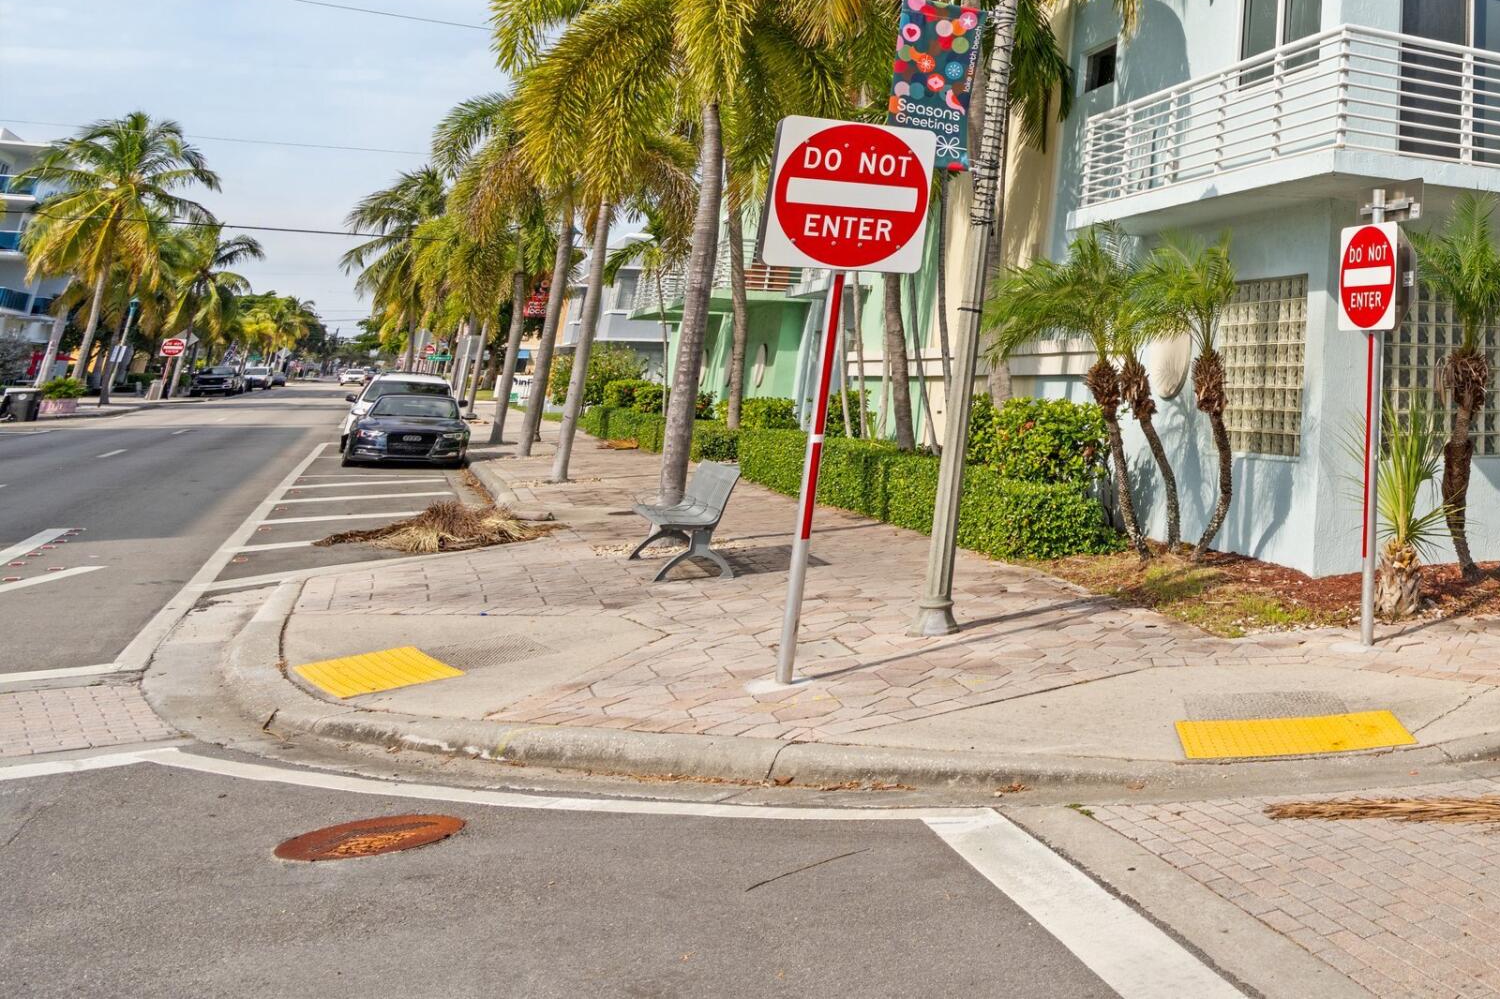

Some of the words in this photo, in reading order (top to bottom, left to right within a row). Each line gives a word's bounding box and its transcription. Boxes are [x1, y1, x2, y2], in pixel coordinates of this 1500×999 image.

[971, 25, 983, 50] beach
[967, 51, 978, 75] worth
[897, 98, 960, 121] Seasons
[895, 112, 960, 134] Greetings
[803, 146, 843, 172] DO
[858, 151, 912, 178] NOT
[803, 214, 893, 241] ENTER
[1349, 246, 1362, 263] DO
[1368, 244, 1388, 262] NOT
[1350, 291, 1382, 309] ENTER
